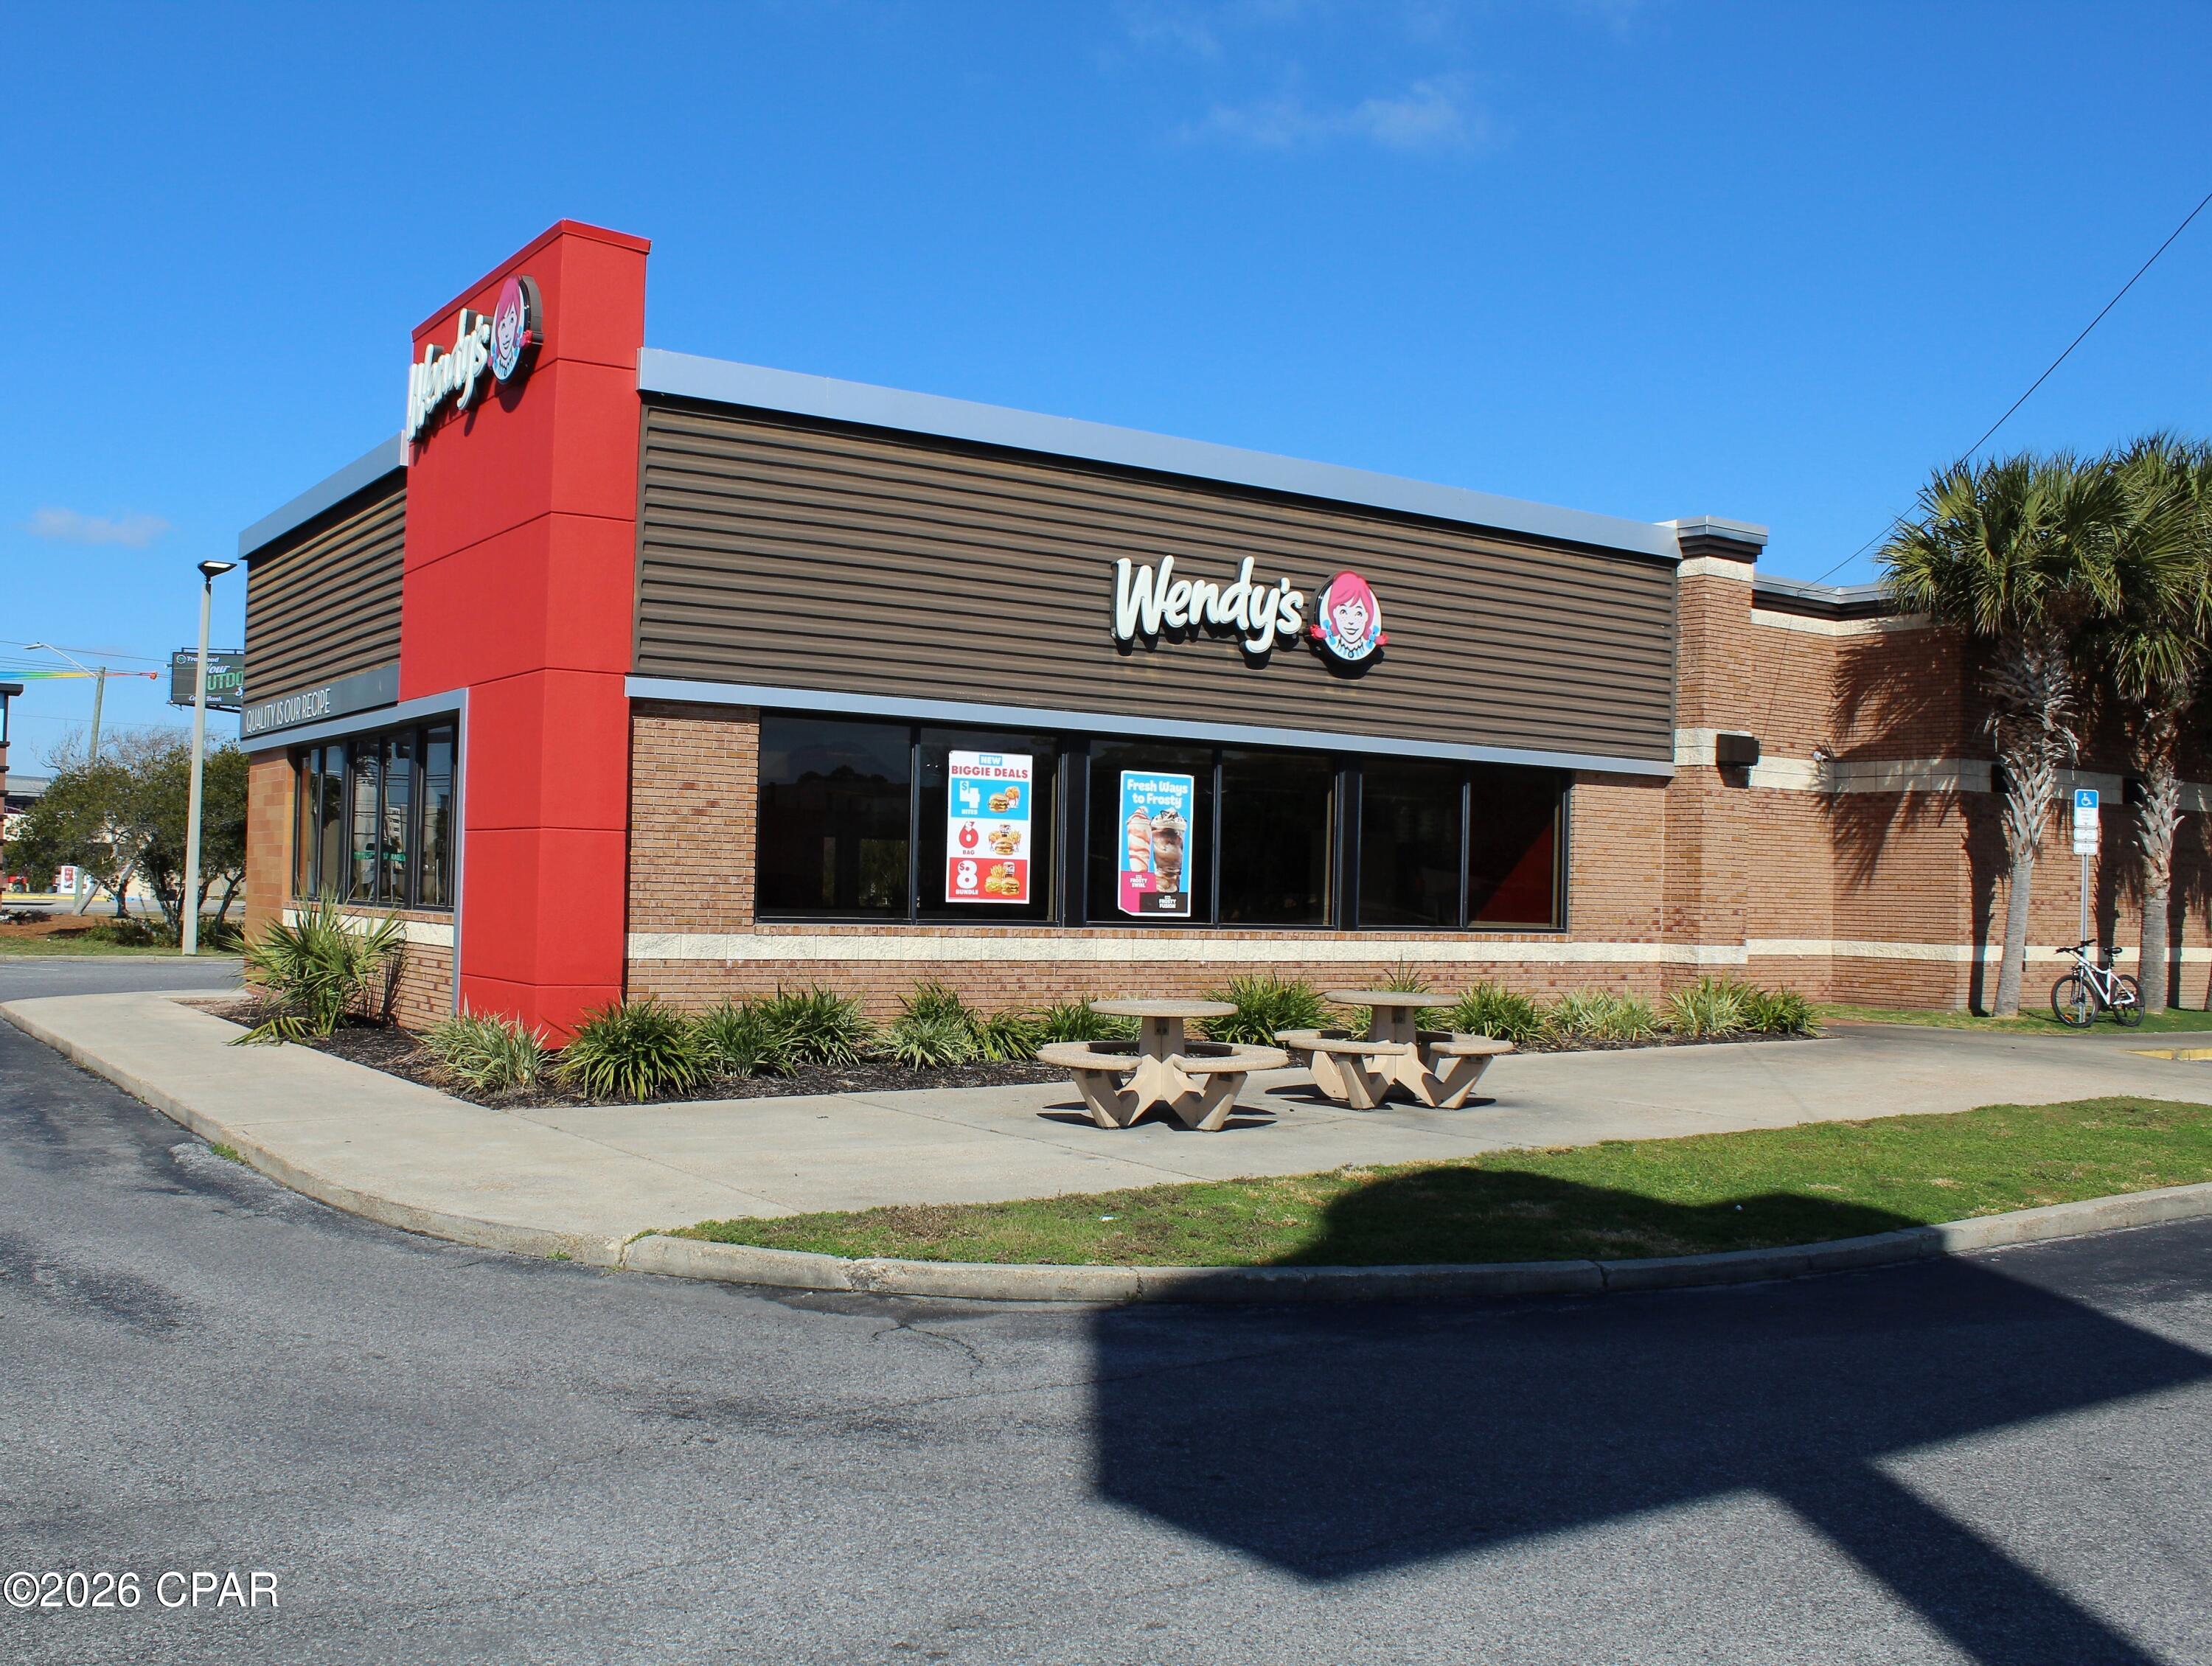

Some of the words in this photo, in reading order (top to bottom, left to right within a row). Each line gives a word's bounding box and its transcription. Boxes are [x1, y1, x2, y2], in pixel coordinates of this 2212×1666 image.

[406, 307, 491, 442] Wendy's
[1115, 554, 1304, 654] Wendy's
[246, 703, 276, 733] QUALITY
[276, 701, 284, 725] IS
[285, 697, 301, 723] OUR
[302, 688, 331, 719] RECIPE
[980, 756, 1001, 765] NEW
[951, 766, 990, 776] BIGGIE
[994, 768, 1028, 778] DEALS
[1127, 778, 1158, 792] Fresh
[1158, 781, 1189, 796] Ways
[1132, 792, 1145, 804] to
[1147, 792, 1183, 809] Frosty
